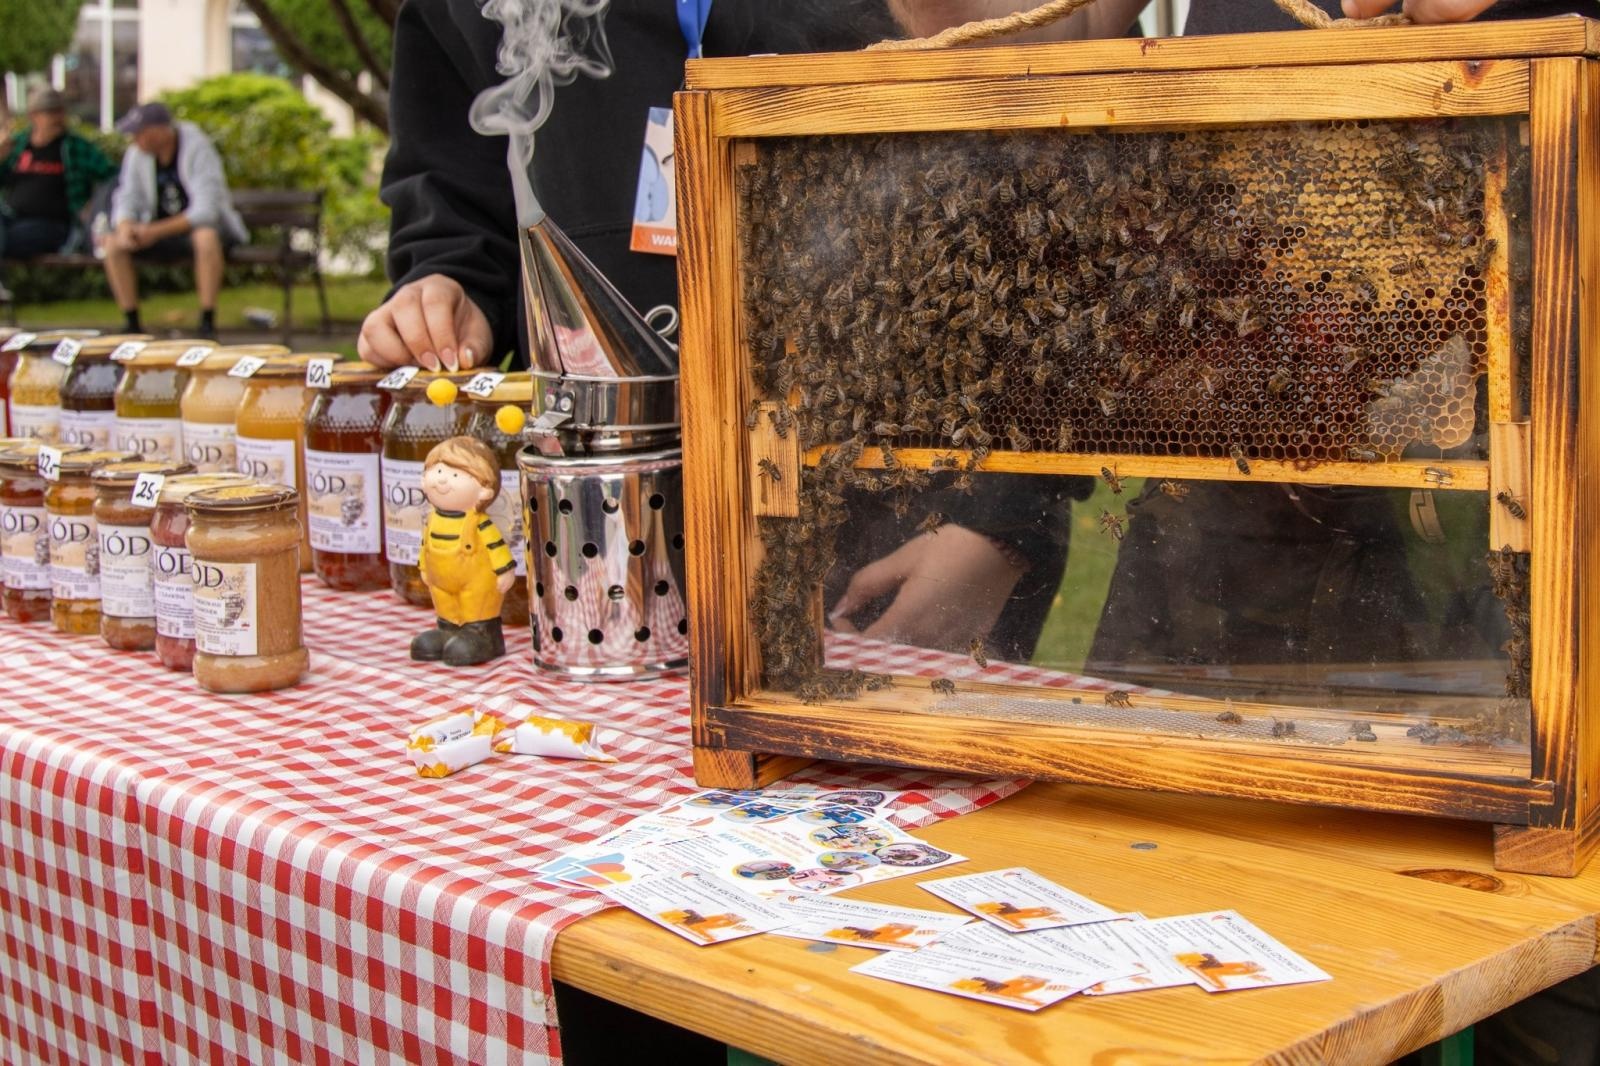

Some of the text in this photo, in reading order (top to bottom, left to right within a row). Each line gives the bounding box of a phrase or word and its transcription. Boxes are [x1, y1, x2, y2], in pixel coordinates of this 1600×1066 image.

[309, 469, 346, 494] IÓD
[386, 481, 426, 506] IÓD
[101, 530, 151, 556] IÓD
